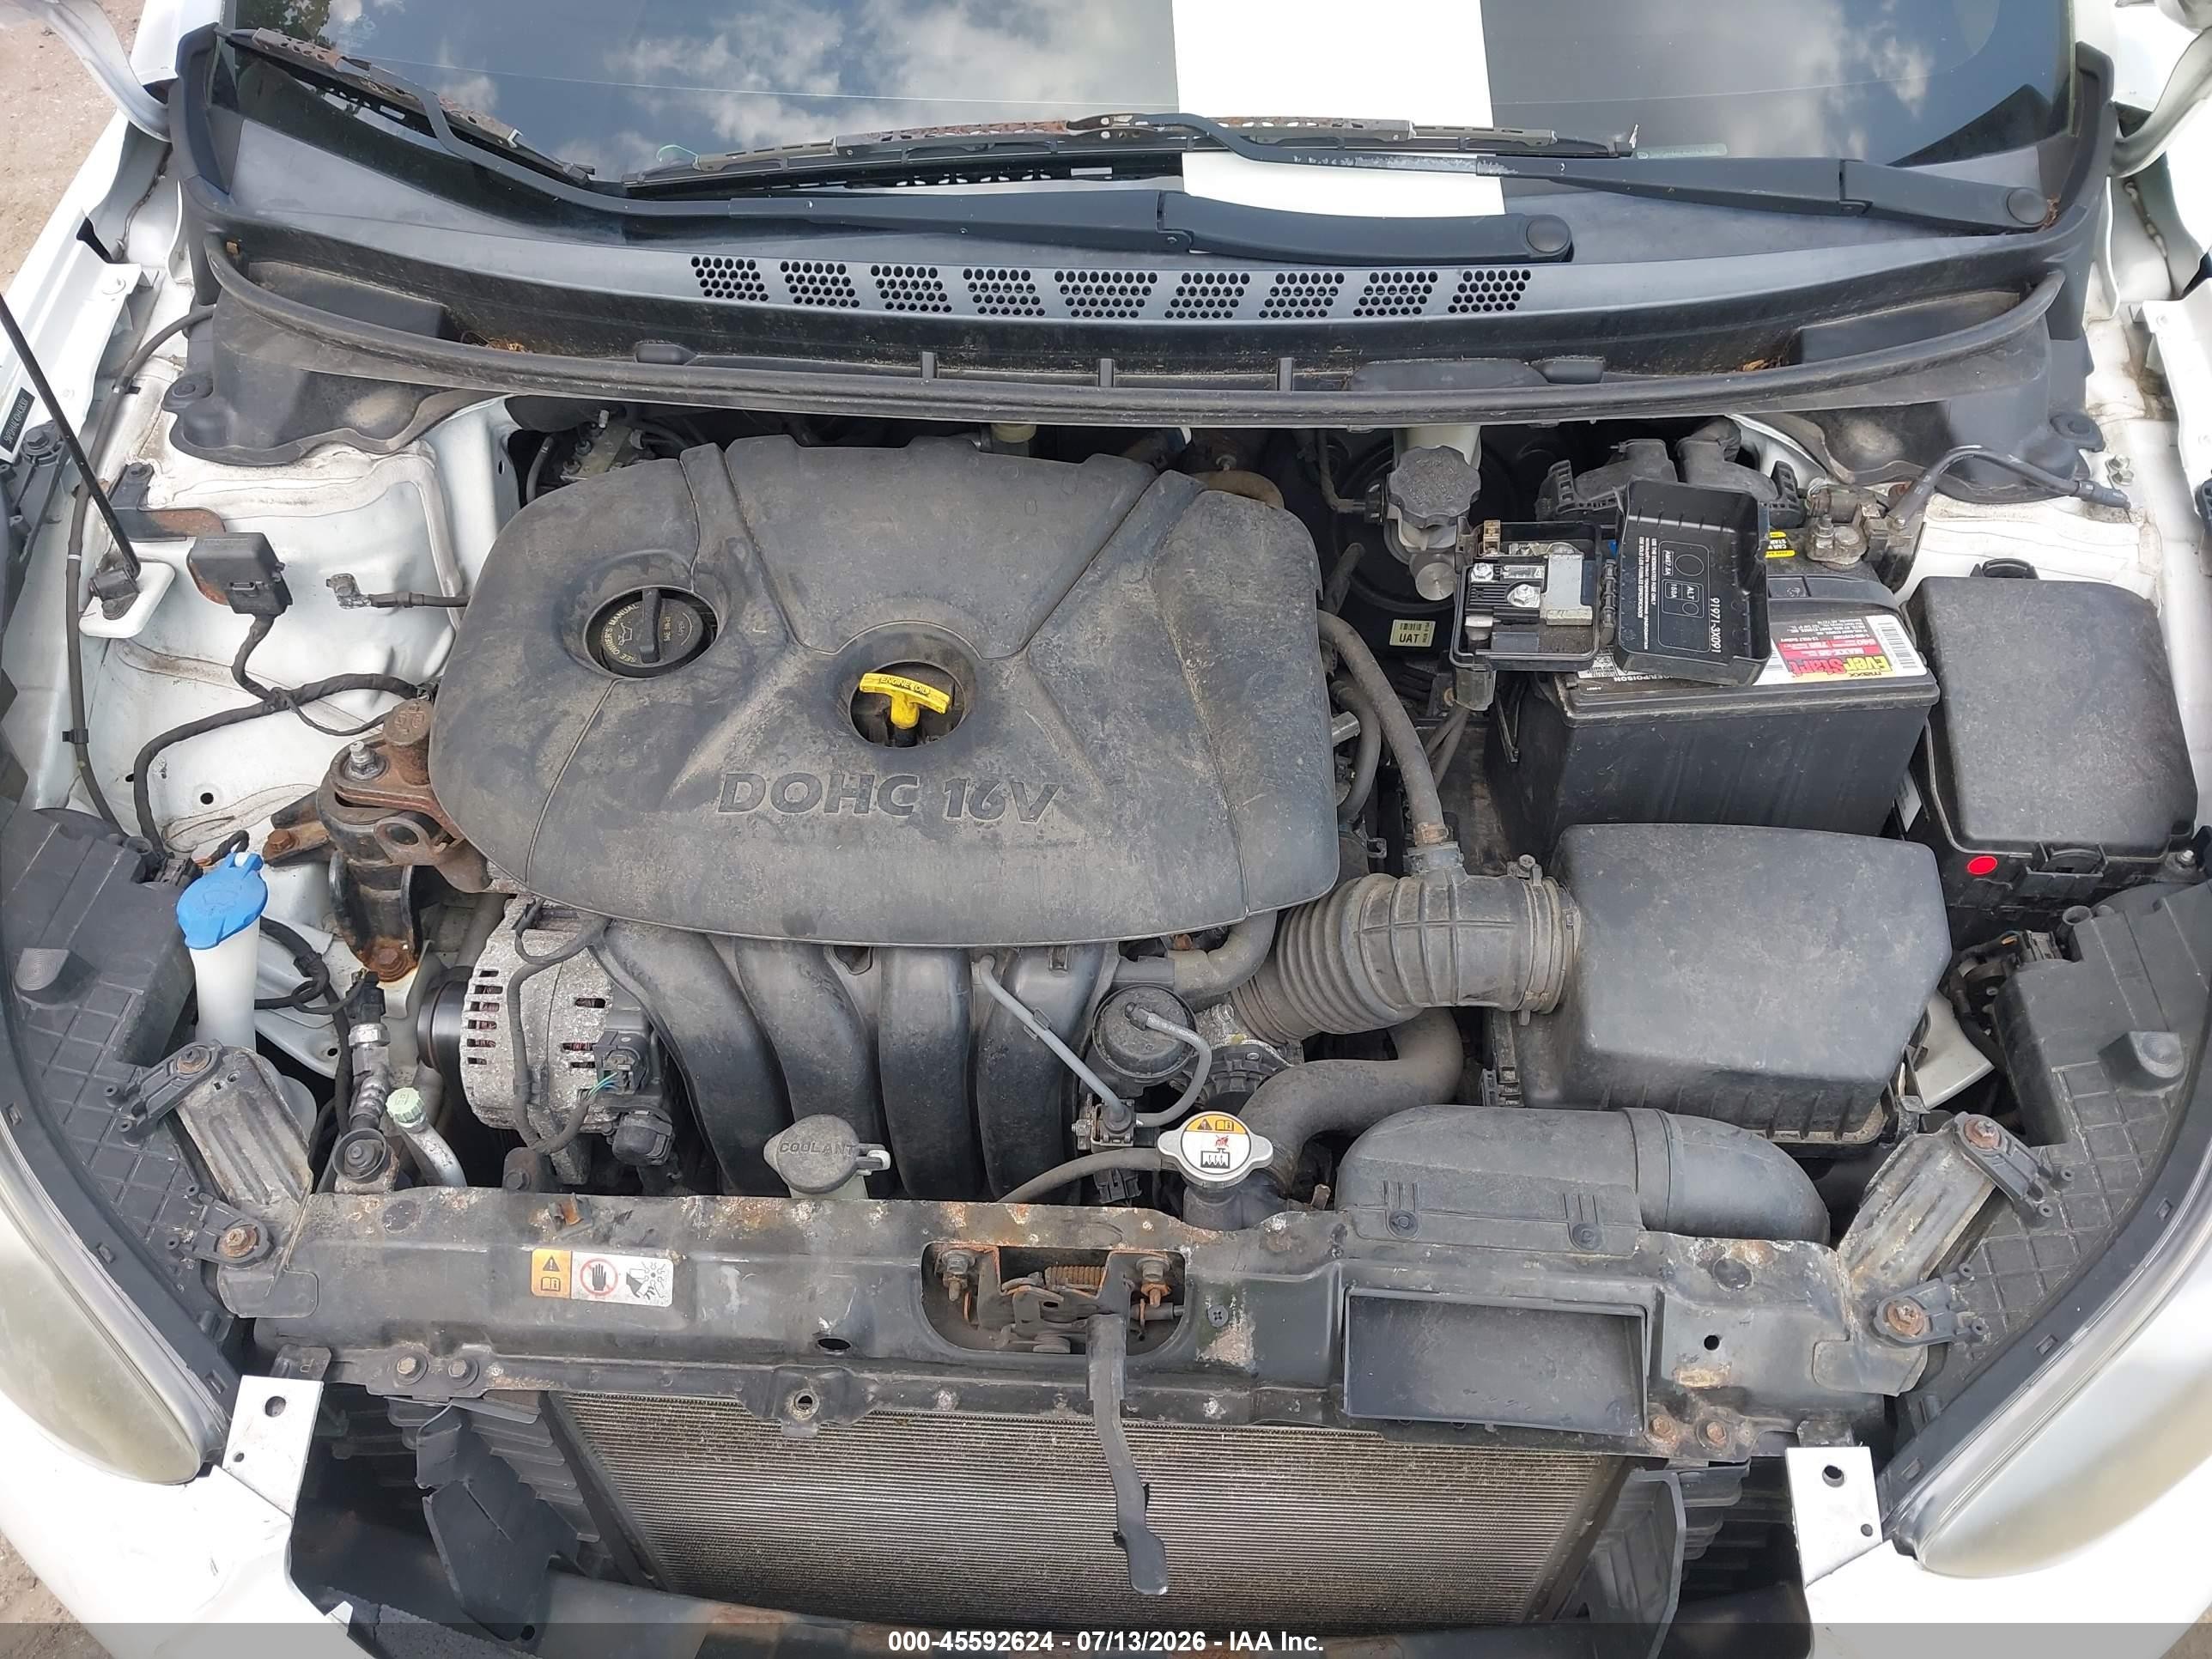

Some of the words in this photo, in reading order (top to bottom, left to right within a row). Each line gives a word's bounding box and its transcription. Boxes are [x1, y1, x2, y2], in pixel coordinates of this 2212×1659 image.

[608, 604, 640, 626] MANUAL
[1710, 597, 1722, 653] 91971-3X091
[1400, 633, 1419, 643] UAT
[1789, 655, 1893, 677] EverStart
[880, 677, 911, 689] ENGINE
[914, 684, 930, 695] OIL
[718, 772, 921, 817] DOHC
[943, 778, 1061, 823] 16V
[779, 1141, 856, 1156] COOLANT
